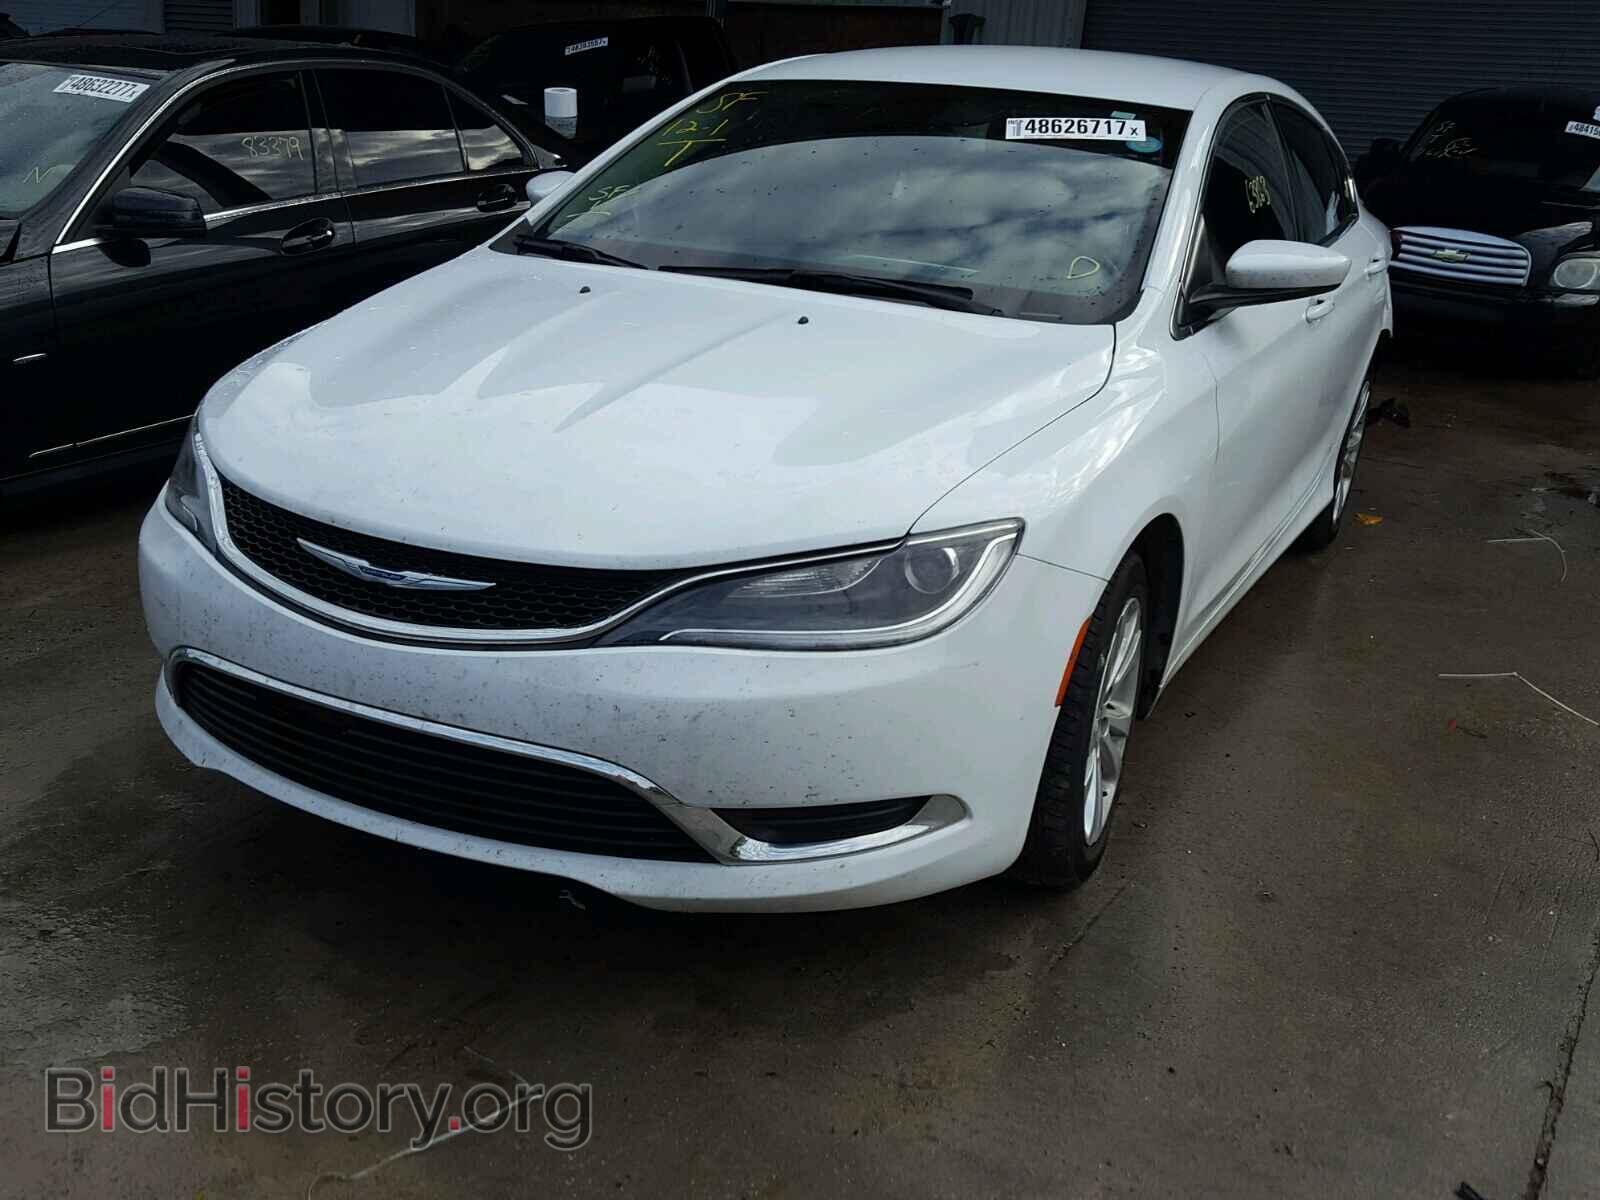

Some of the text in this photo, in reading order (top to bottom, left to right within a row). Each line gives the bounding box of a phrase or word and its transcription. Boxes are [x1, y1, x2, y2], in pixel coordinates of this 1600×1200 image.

[1024, 118, 1127, 136] 48626717
[1574, 123, 1600, 138] 48415
[242, 136, 304, 161] 83379
